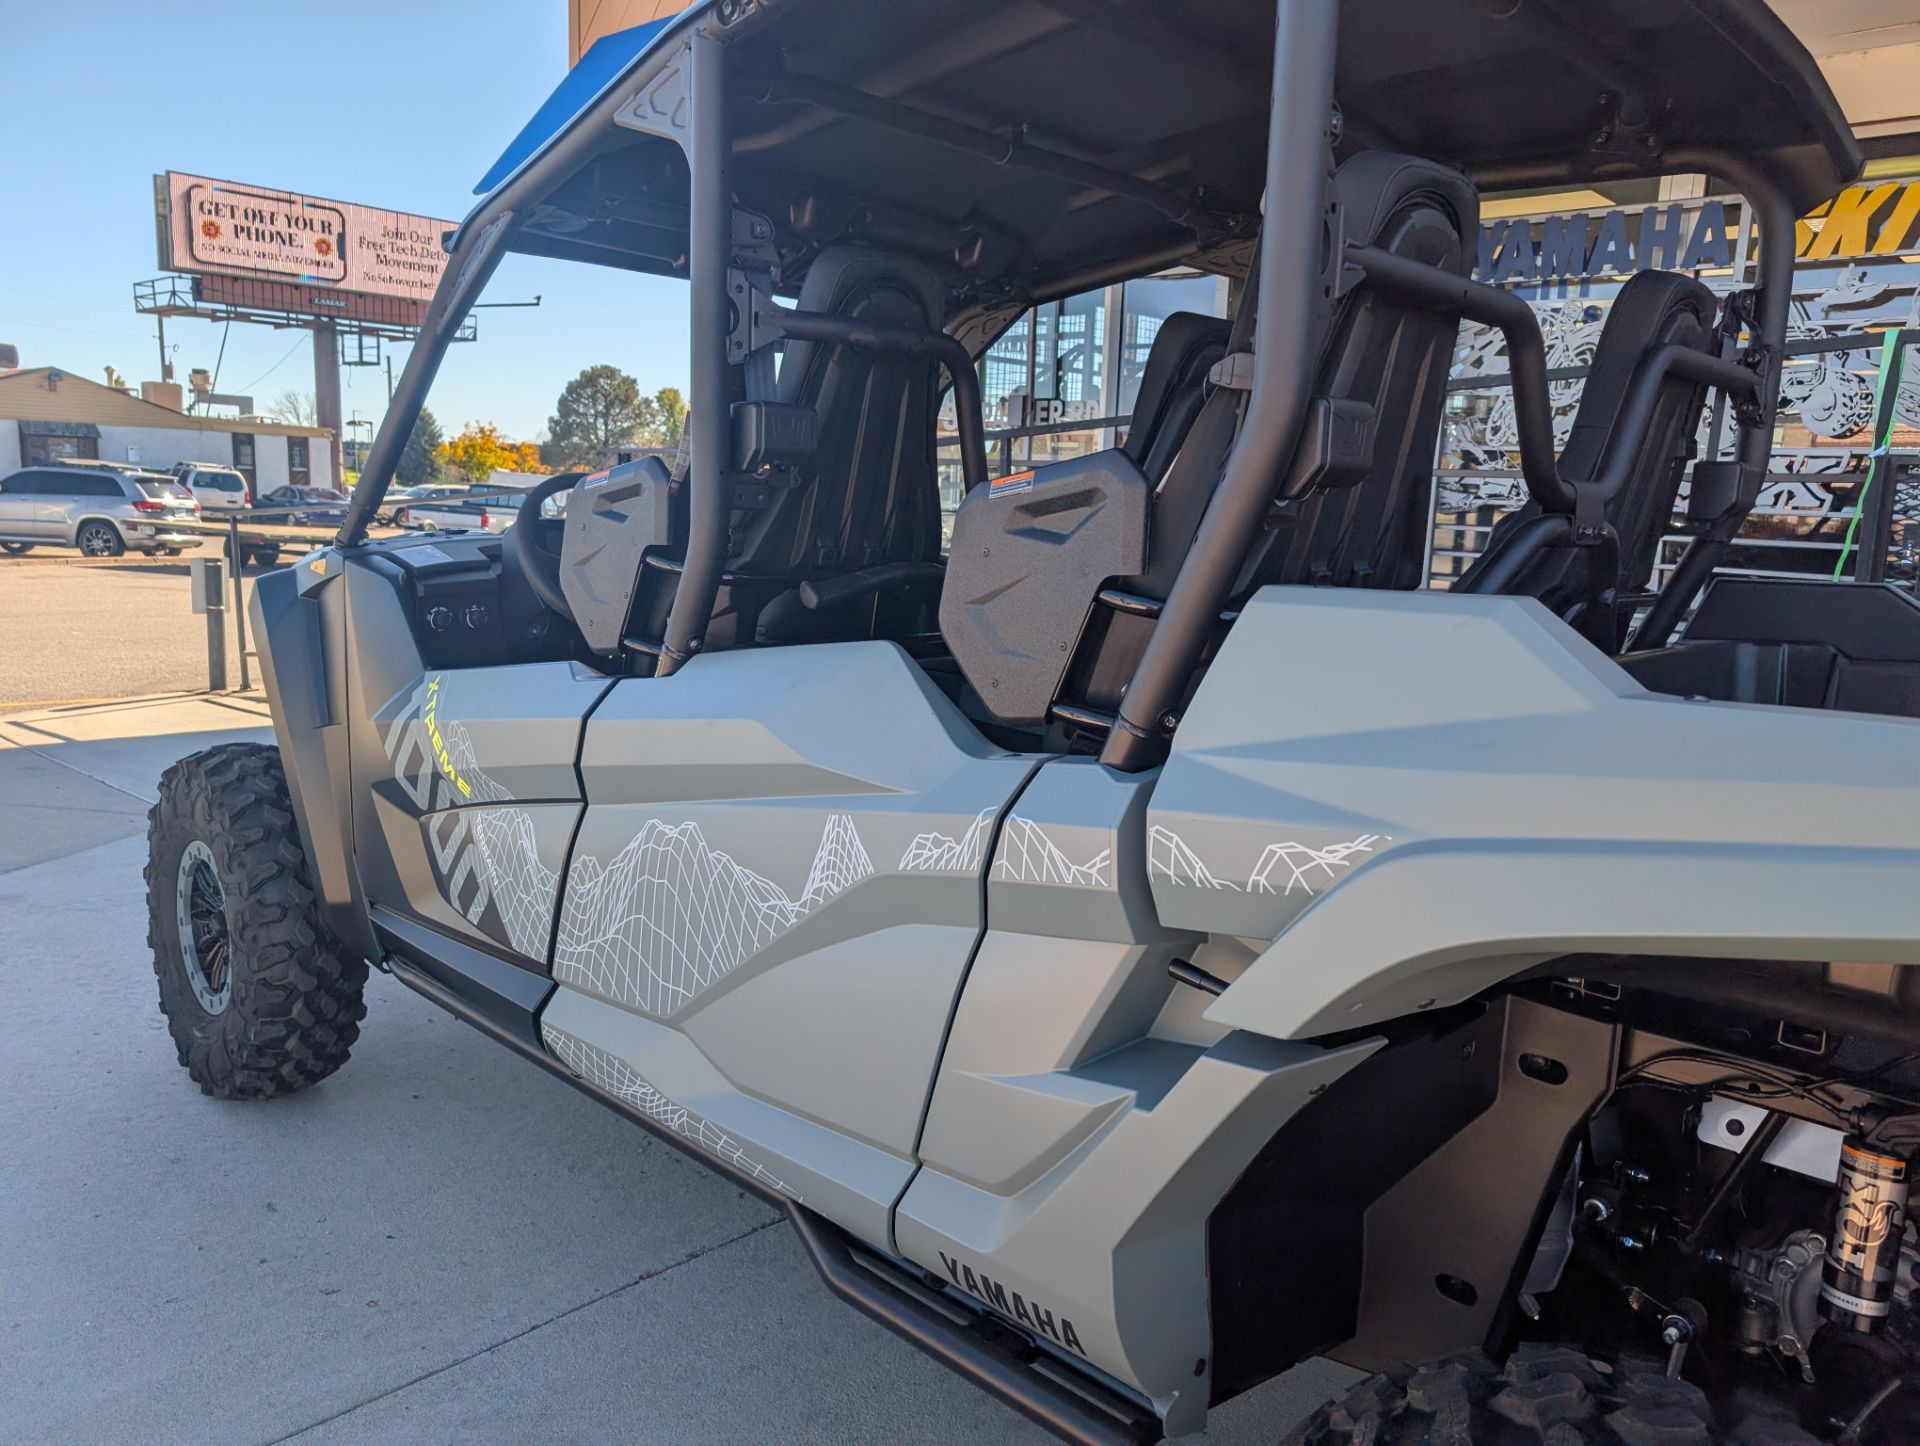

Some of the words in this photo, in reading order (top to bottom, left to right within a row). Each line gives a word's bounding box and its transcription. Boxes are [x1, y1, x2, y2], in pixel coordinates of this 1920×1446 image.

[198, 199, 239, 219] GET
[243, 207, 279, 225] OFF
[284, 214, 333, 235] YOUR
[233, 224, 304, 249] PHONE.
[359, 236, 386, 252] Free
[388, 241, 418, 257] Tech
[420, 246, 449, 262] Deto
[381, 226, 407, 241] Join
[410, 231, 433, 245] Our
[1477, 200, 1731, 282] YAMAHA
[376, 253, 439, 273] Movement
[1832, 1174, 1898, 1267] FOX
[937, 1250, 1088, 1357] YAMAHA
